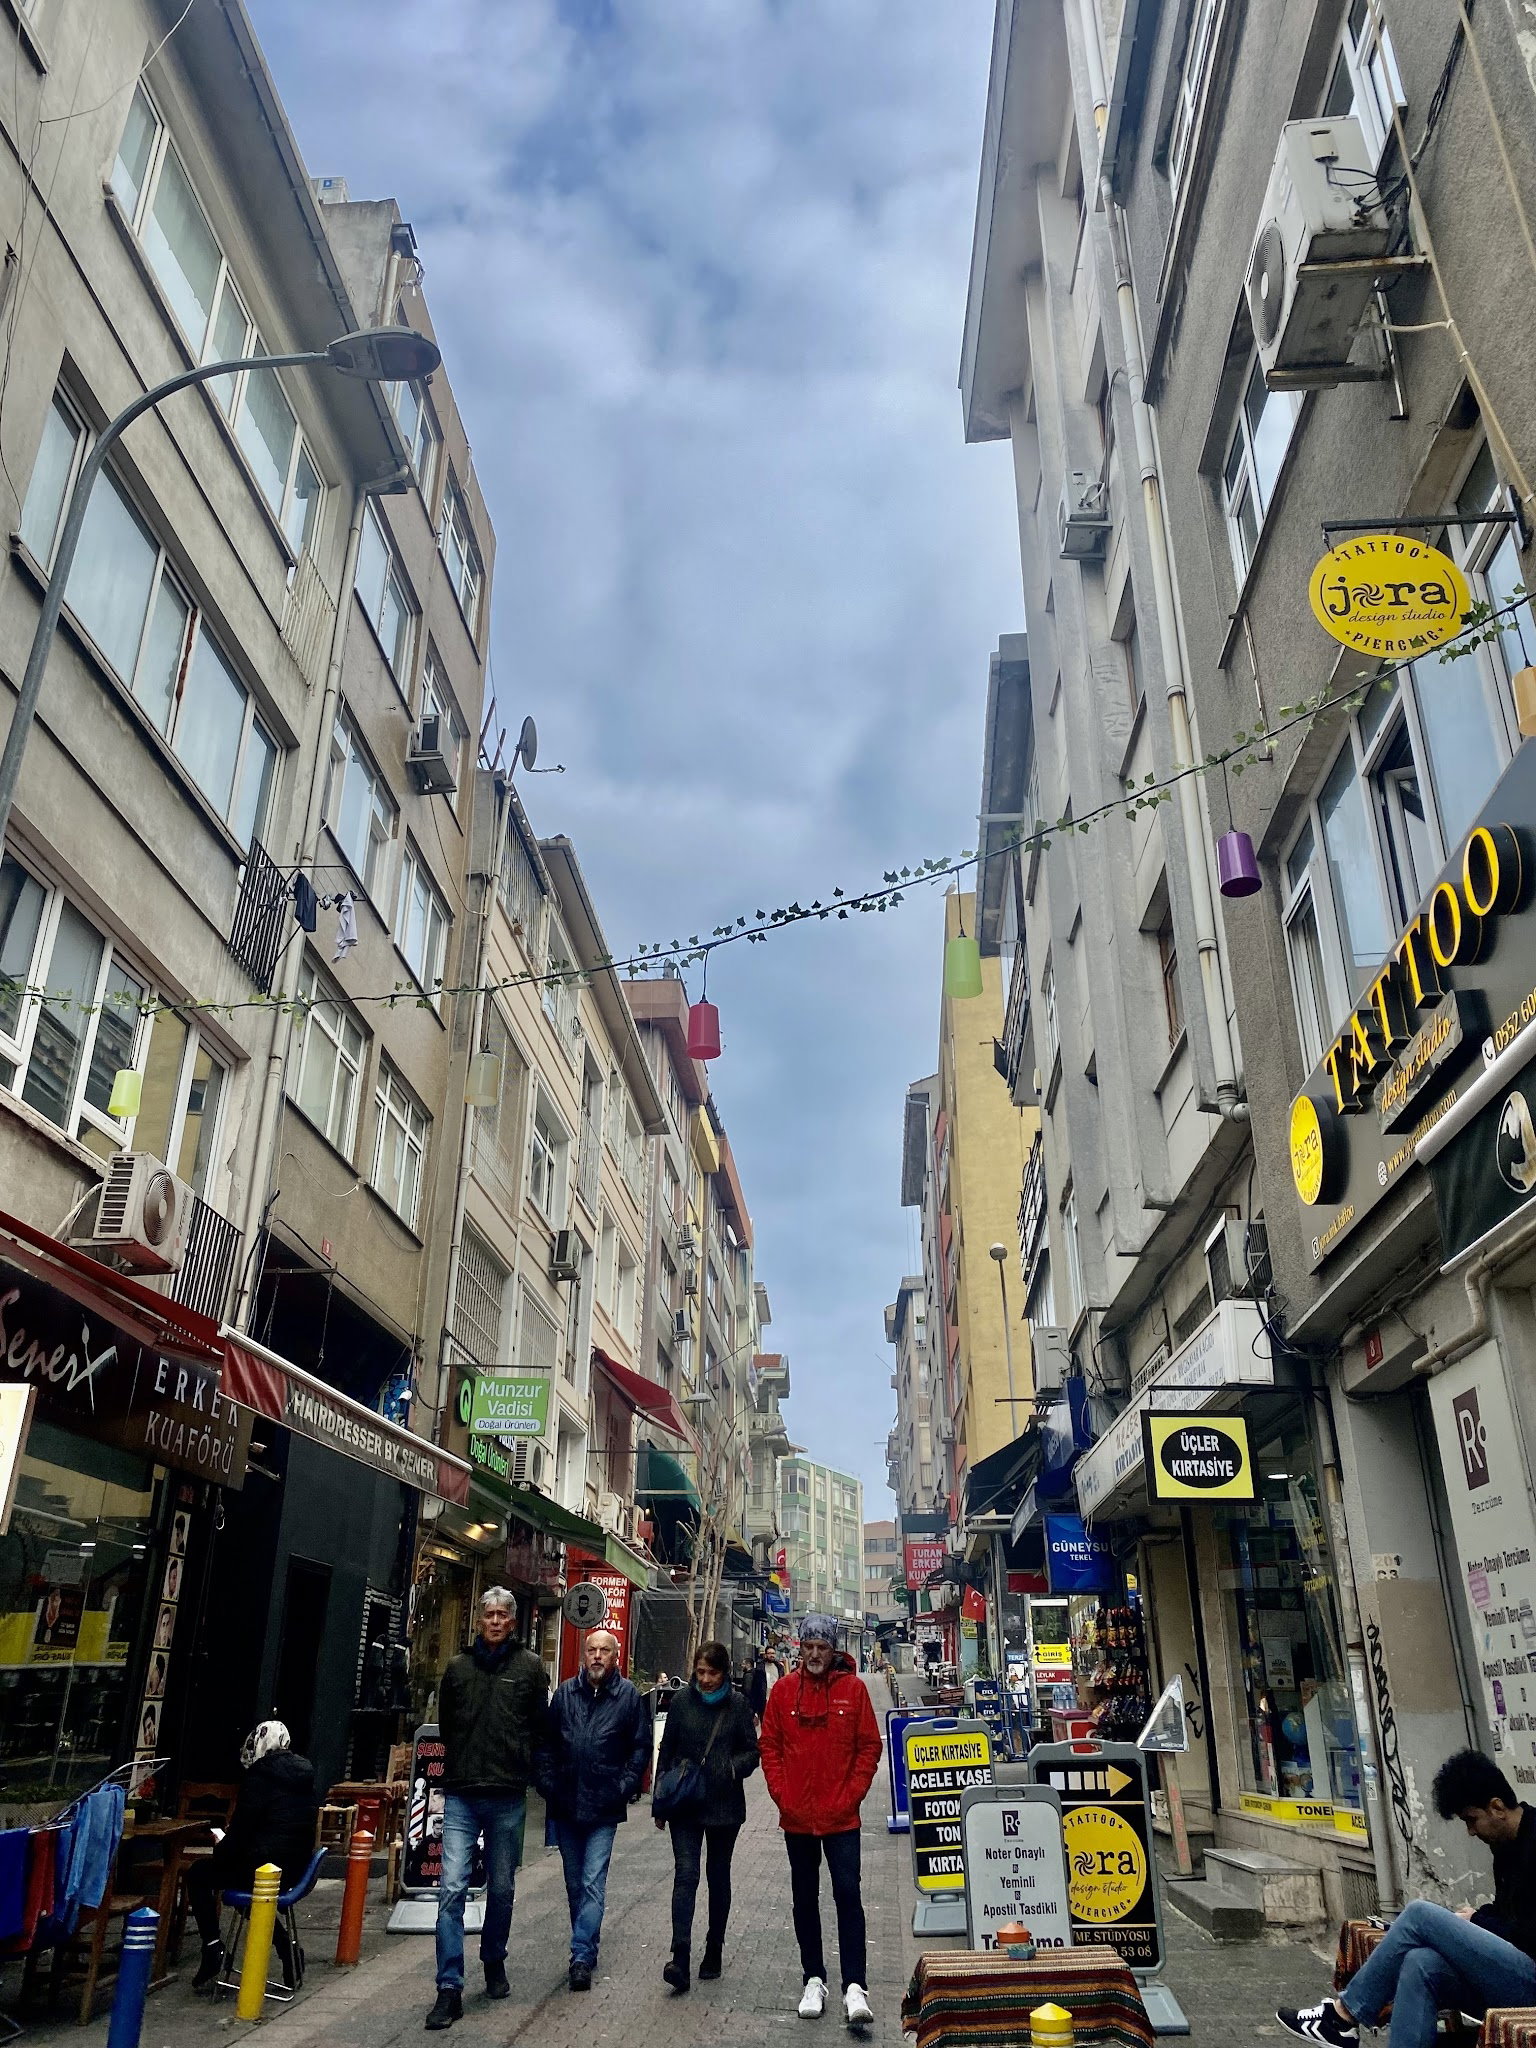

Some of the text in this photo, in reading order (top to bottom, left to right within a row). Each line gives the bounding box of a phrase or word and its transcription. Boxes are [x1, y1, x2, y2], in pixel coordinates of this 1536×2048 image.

[1342, 541, 1420, 561] TATTOO
[1348, 608, 1448, 627] design studio
[1324, 826, 1504, 1115] TATTOO
[1495, 986, 1536, 1051] 0552 60
[1381, 1012, 1451, 1114] design studio
[1369, 1339, 1377, 1358] 8
[480, 1380, 542, 1398] Munzur
[487, 1399, 534, 1417] Vadisi
[292, 1390, 383, 1458] HAIRDRESSER
[384, 1439, 400, 1463] BY
[478, 1419, 537, 1430] Doğal Ürünleri
[144, 1410, 235, 1475] KUAFÖRÜ
[1180, 1431, 1220, 1456] ÜÇLER
[1171, 1456, 1235, 1478] KIRTASİYE
[912, 1548, 943, 1558] TURAN
[1052, 1540, 1109, 1553] GÜNEYSU
[912, 1559, 943, 1569] ERKEK
[1069, 1553, 1093, 1561] TEKEL
[591, 1576, 628, 1586] FORMEN
[593, 1618, 624, 1631] AKAL
[913, 1739, 983, 1766] ÜÇLER KIRTASİYE
[910, 1770, 953, 1790] ACELE
[1069, 1813, 1116, 1828] TATTOO
[985, 1846, 1046, 1861] Noter Onaylı
[999, 1875, 1036, 1889] Yeminli
[1070, 1881, 1101, 1901] design
[983, 1901, 1058, 1919] Apostil Tasdikli
[1074, 1900, 1127, 1919] PIERCING
[1093, 1928, 1151, 1943] STÜDYOSU
[1120, 1947, 1136, 1958] 53
